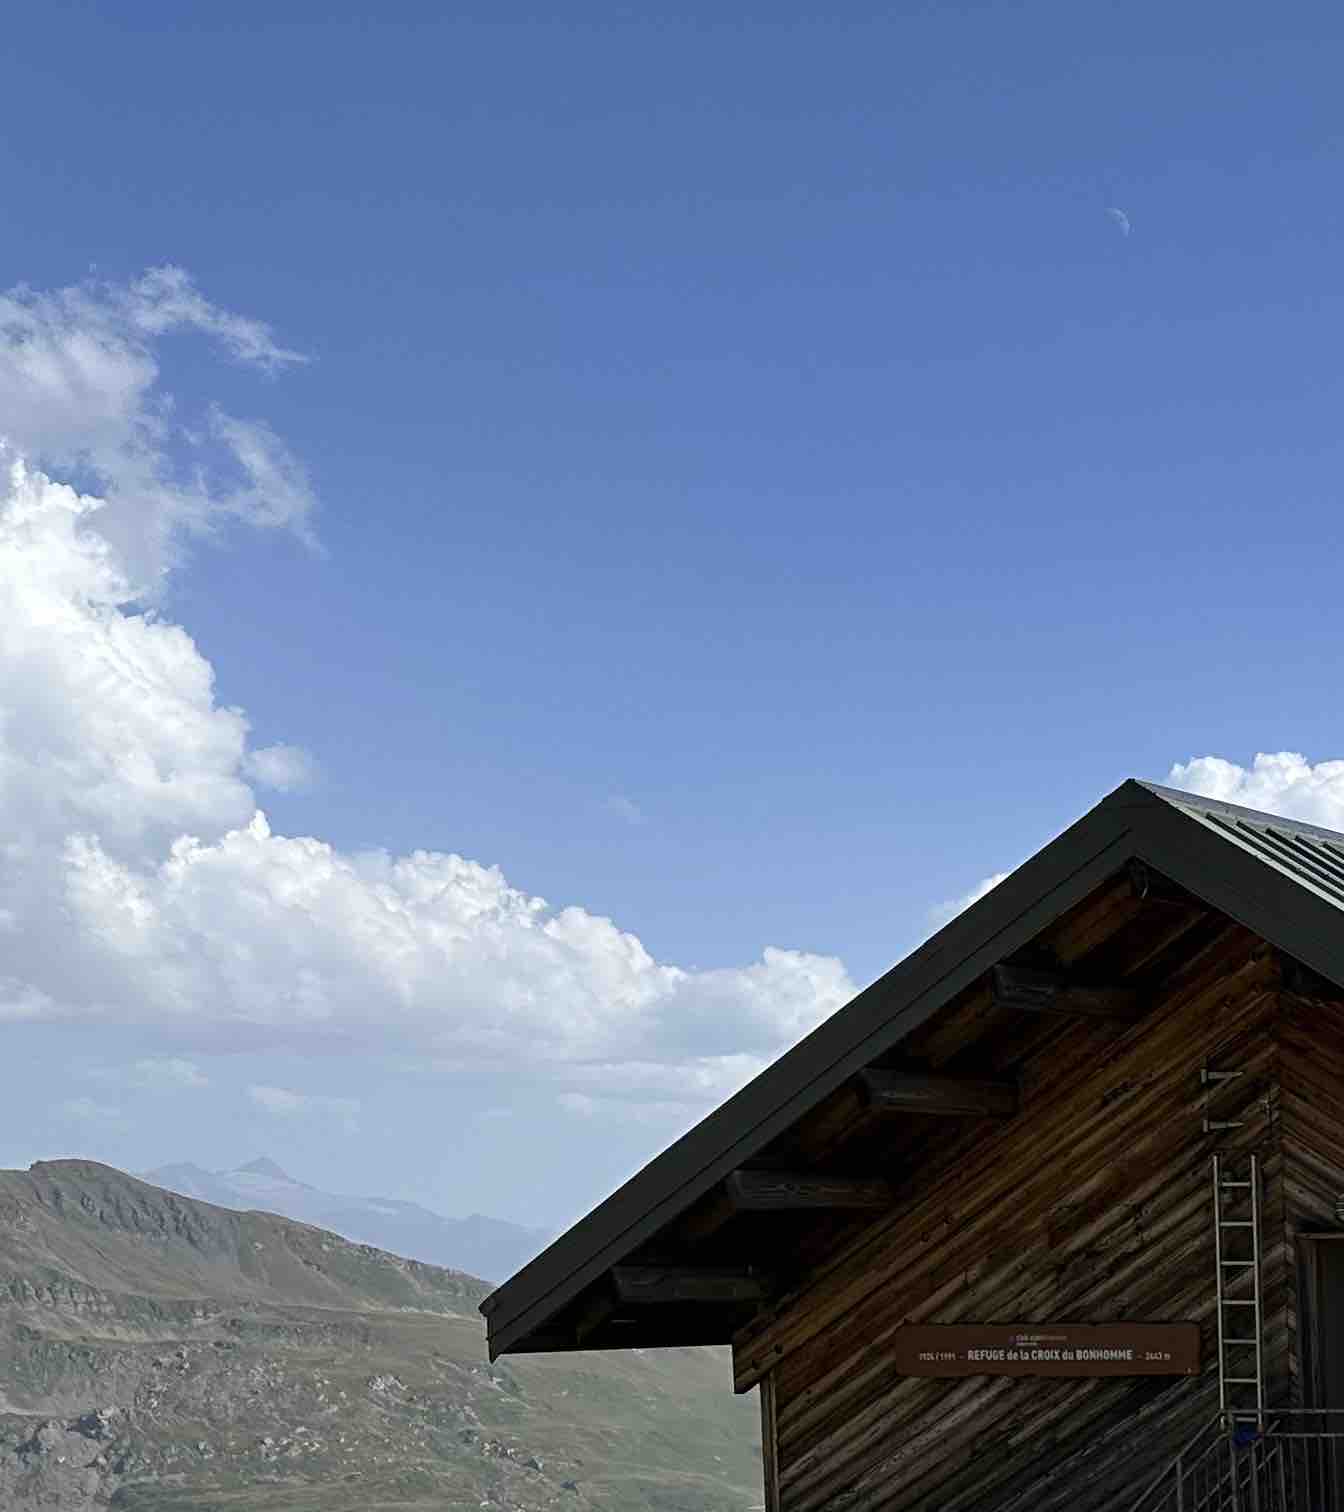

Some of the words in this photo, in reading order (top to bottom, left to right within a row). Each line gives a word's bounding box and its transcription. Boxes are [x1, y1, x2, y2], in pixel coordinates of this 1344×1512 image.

[967, 1350, 1005, 1361] REFUGE
[1006, 1350, 1018, 1361] de
[1019, 1350, 1030, 1361] la
[1031, 1350, 1060, 1361] CROIX
[1062, 1350, 1074, 1361] du
[1076, 1350, 1133, 1361] BONHOMME
